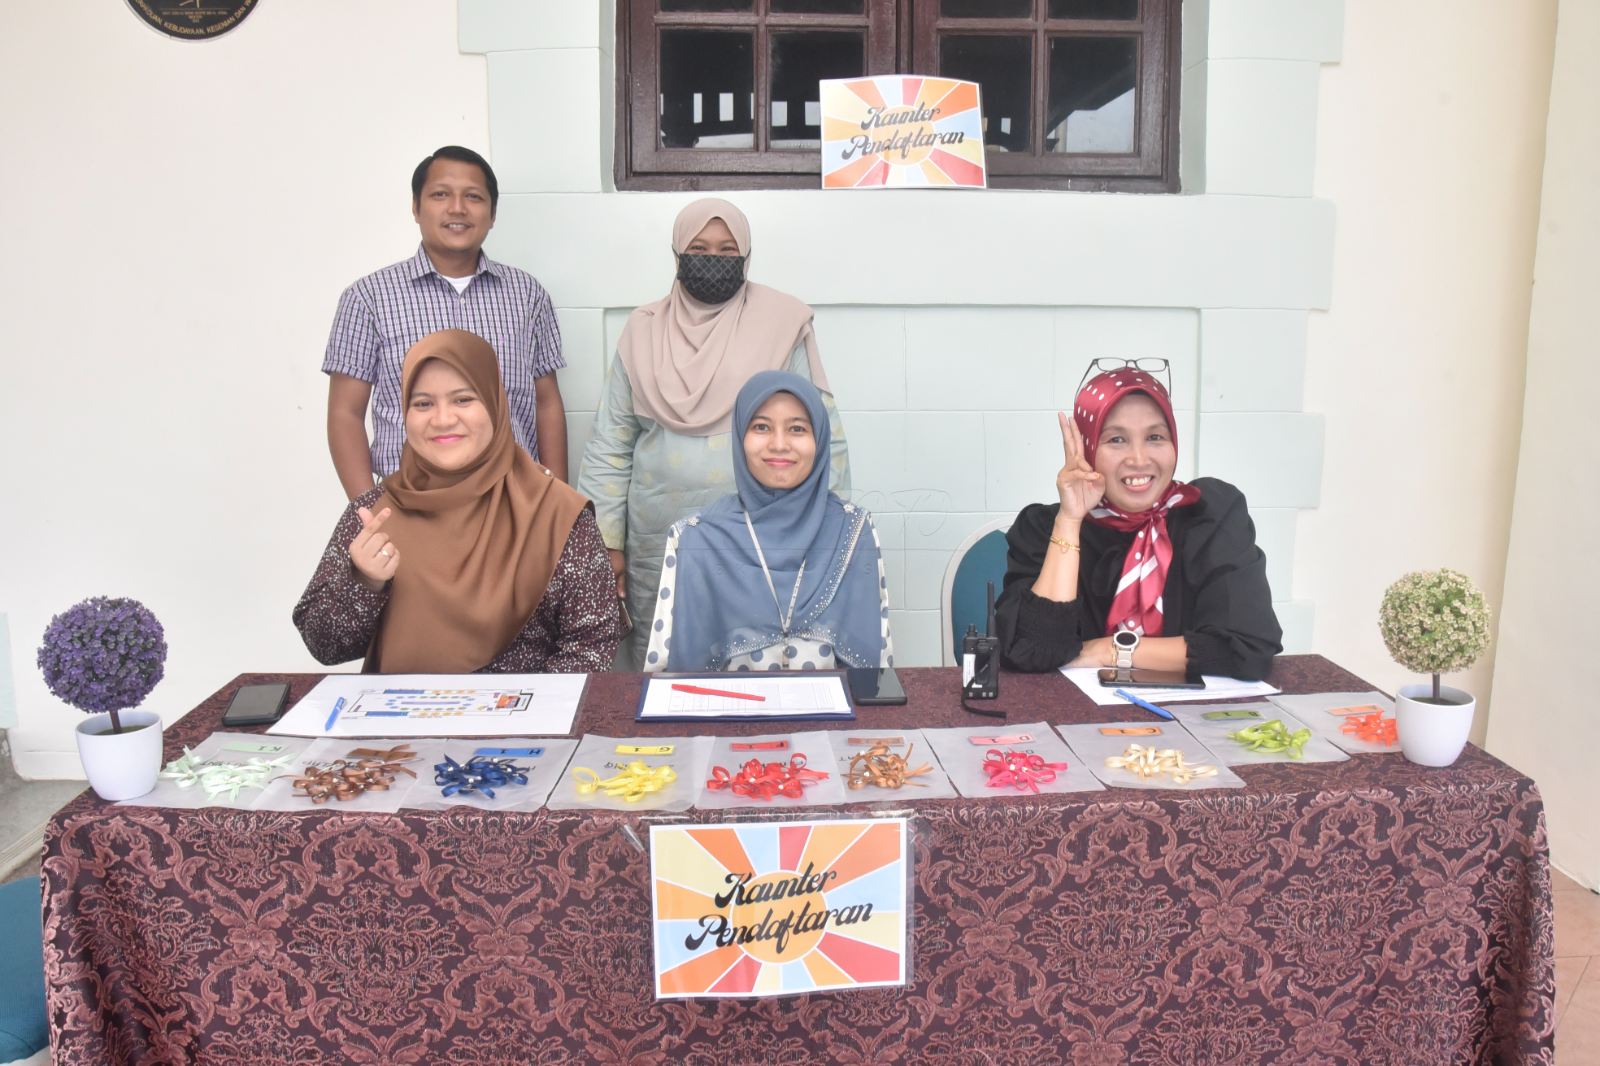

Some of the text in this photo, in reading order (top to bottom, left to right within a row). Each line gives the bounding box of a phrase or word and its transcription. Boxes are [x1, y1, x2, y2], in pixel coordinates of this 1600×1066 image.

[860, 101, 941, 131] Kaunter
[841, 127, 965, 160] Pendaftaran
[713, 861, 838, 909] Kaunter
[684, 900, 874, 954] Pendaftaran
